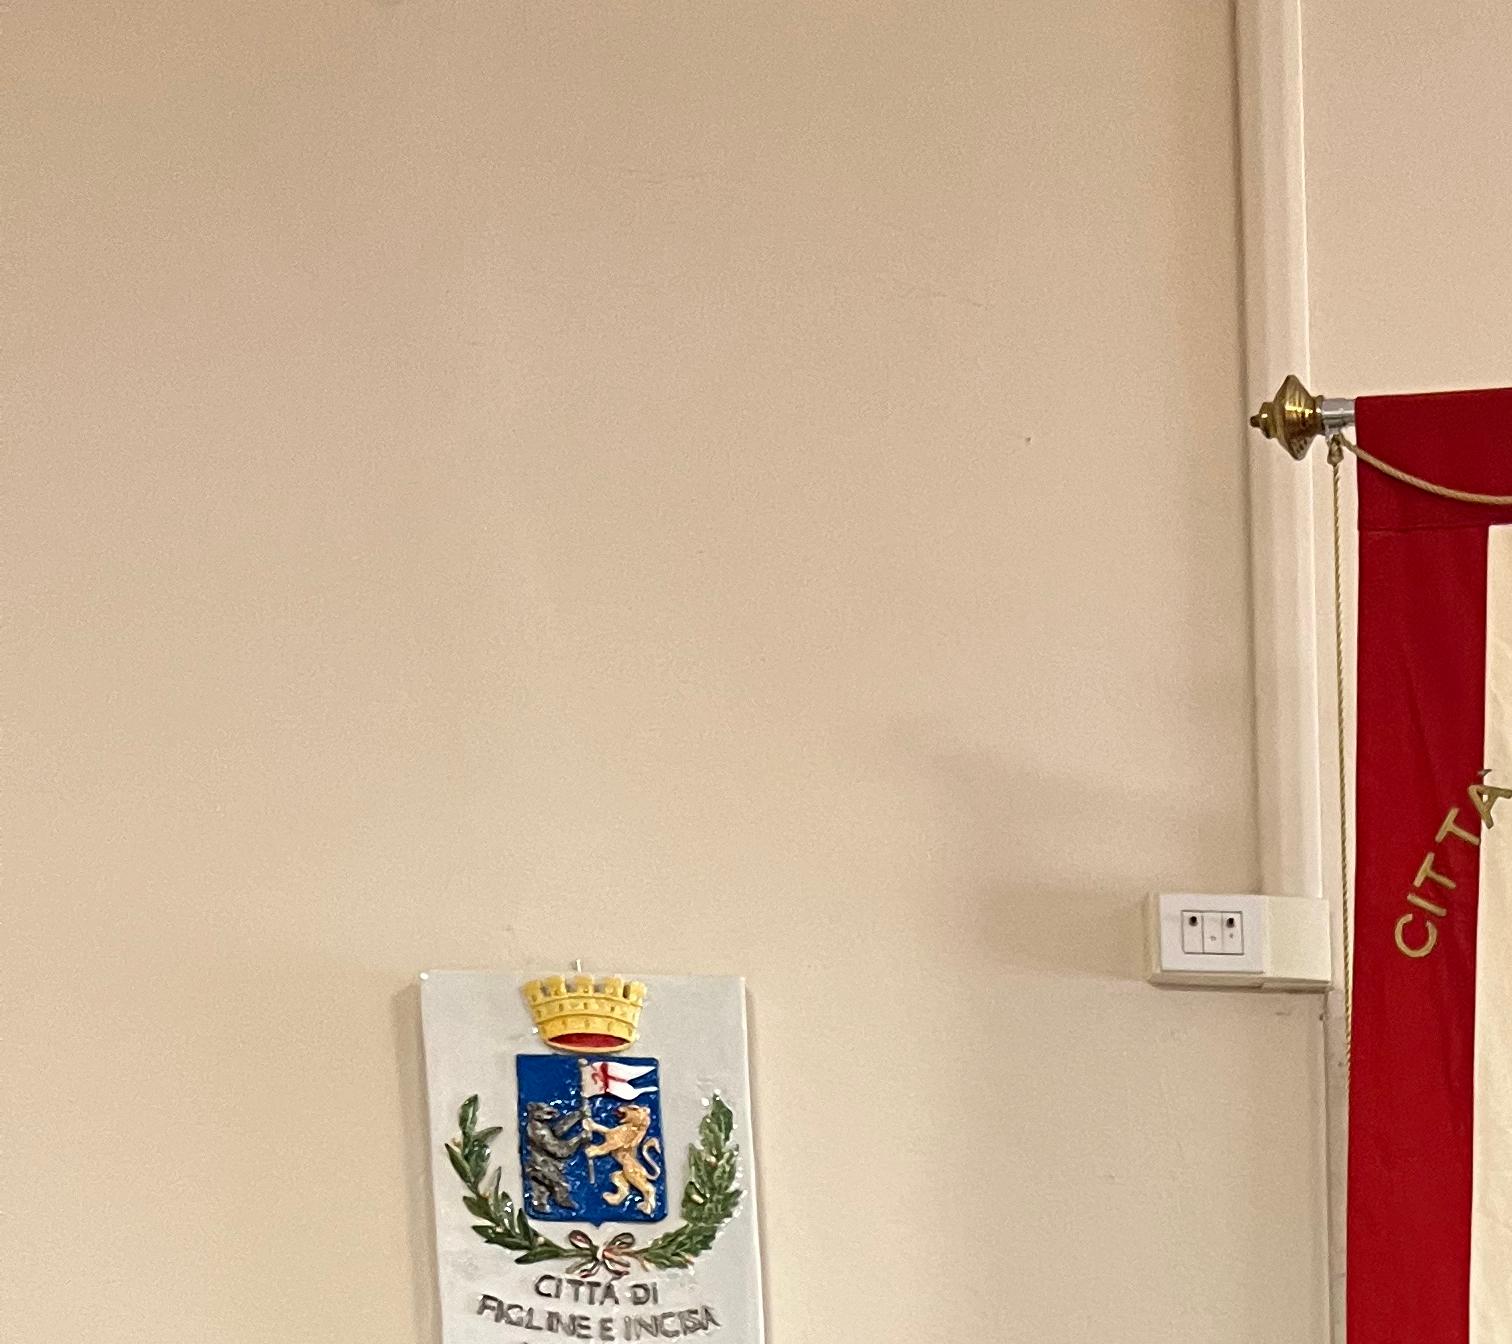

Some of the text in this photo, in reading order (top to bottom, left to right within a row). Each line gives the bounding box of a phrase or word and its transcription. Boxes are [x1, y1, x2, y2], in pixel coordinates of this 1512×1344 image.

[632, 1282, 659, 1307] DI
[476, 1294, 721, 1340] FIGLINE E INCISA
